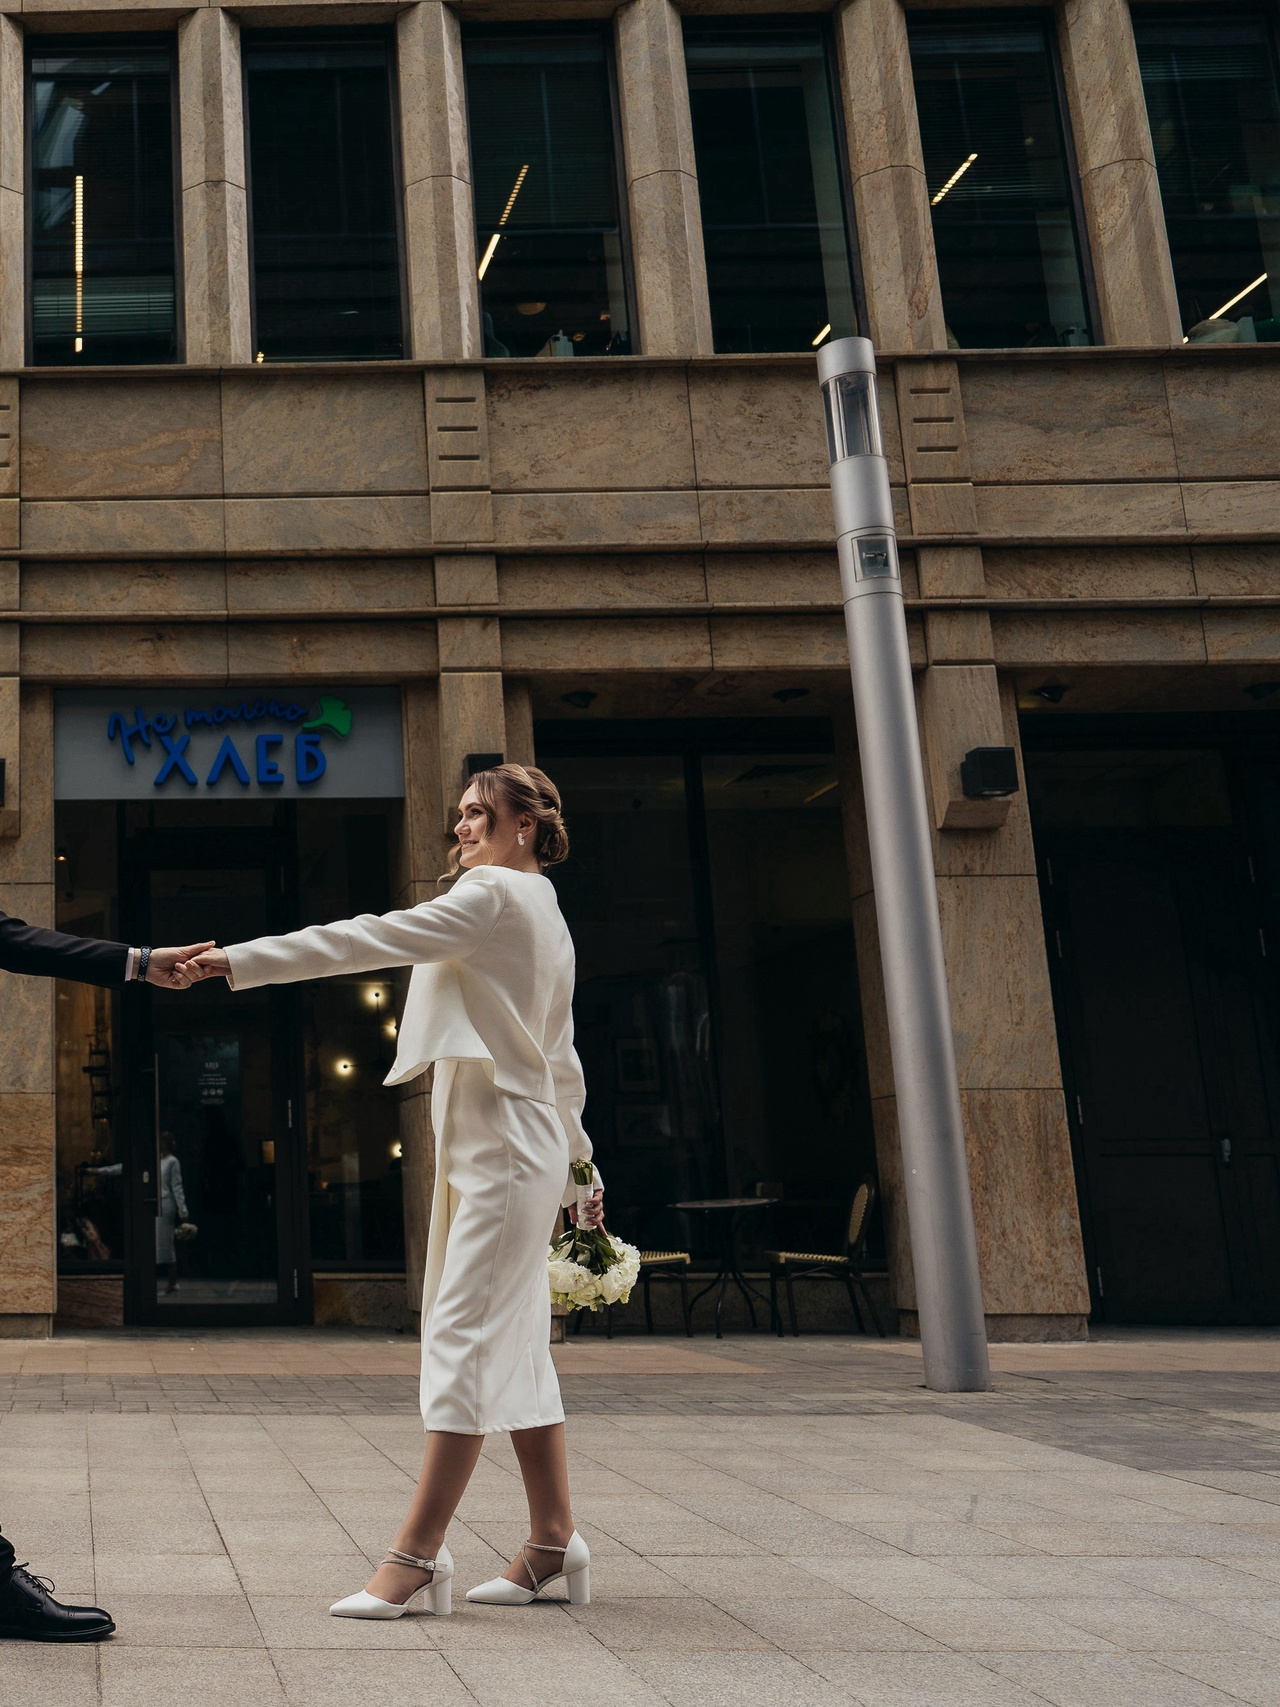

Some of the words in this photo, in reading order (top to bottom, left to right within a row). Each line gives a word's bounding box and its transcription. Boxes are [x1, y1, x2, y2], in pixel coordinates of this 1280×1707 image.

[108, 707, 178, 765] Не
[184, 698, 309, 729] только
[154, 733, 327, 785] ХЛЕБ
